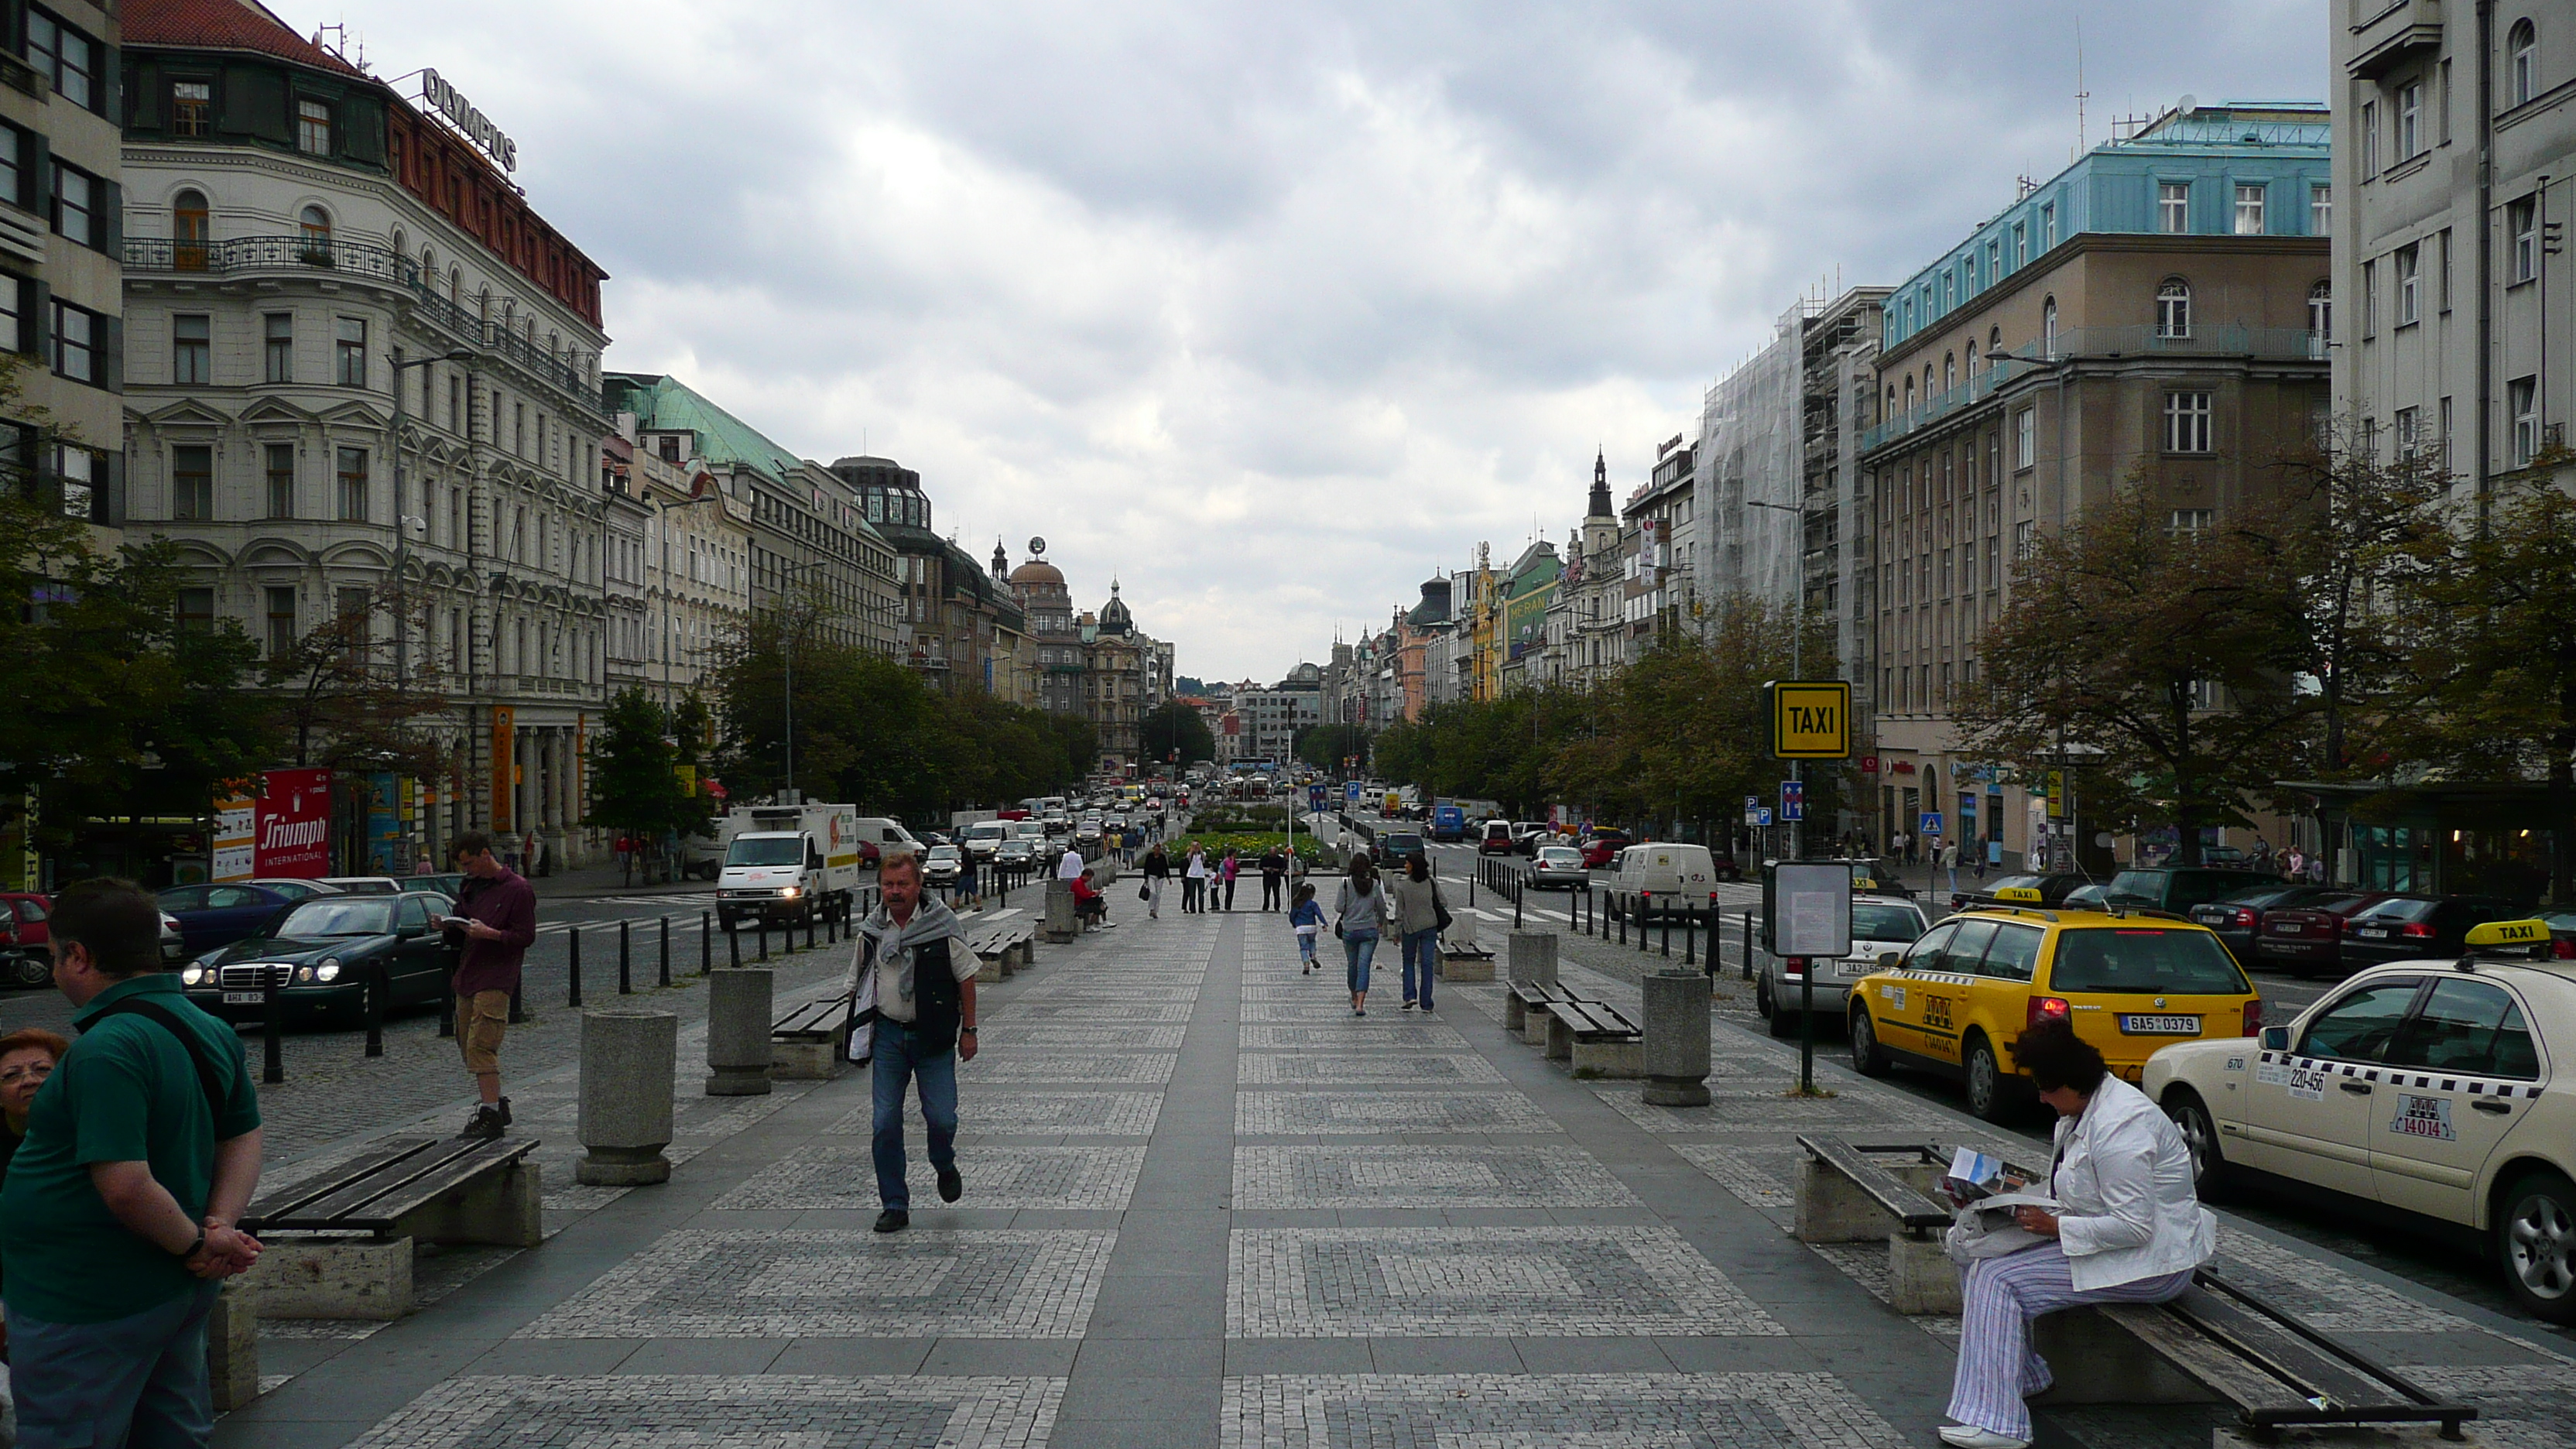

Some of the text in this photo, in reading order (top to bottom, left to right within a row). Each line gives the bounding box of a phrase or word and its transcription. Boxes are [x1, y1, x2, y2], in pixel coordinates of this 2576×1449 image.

[423, 67, 516, 173] OLYMPUS
[1510, 596, 1547, 620] MERAN
[1788, 707, 1834, 734] TAXI
[1349, 784, 1357, 794] P
[1747, 798, 1755, 808] P
[1760, 810, 1768, 820] P
[261, 814, 326, 850] Triumph
[265, 851, 322, 867] INTERNATIONAL
[2499, 926, 2534, 939] TAXI
[1846, 964, 1862, 973] 3A2
[1923, 994, 1954, 1030] AAA
[2131, 1017, 2194, 1031] 6A5 0379
[2227, 1058, 2243, 1069] 670
[2290, 1068, 2324, 1092] 220-456
[2406, 1097, 2440, 1120] AAA
[2403, 1118, 2441, 1137] 14014
